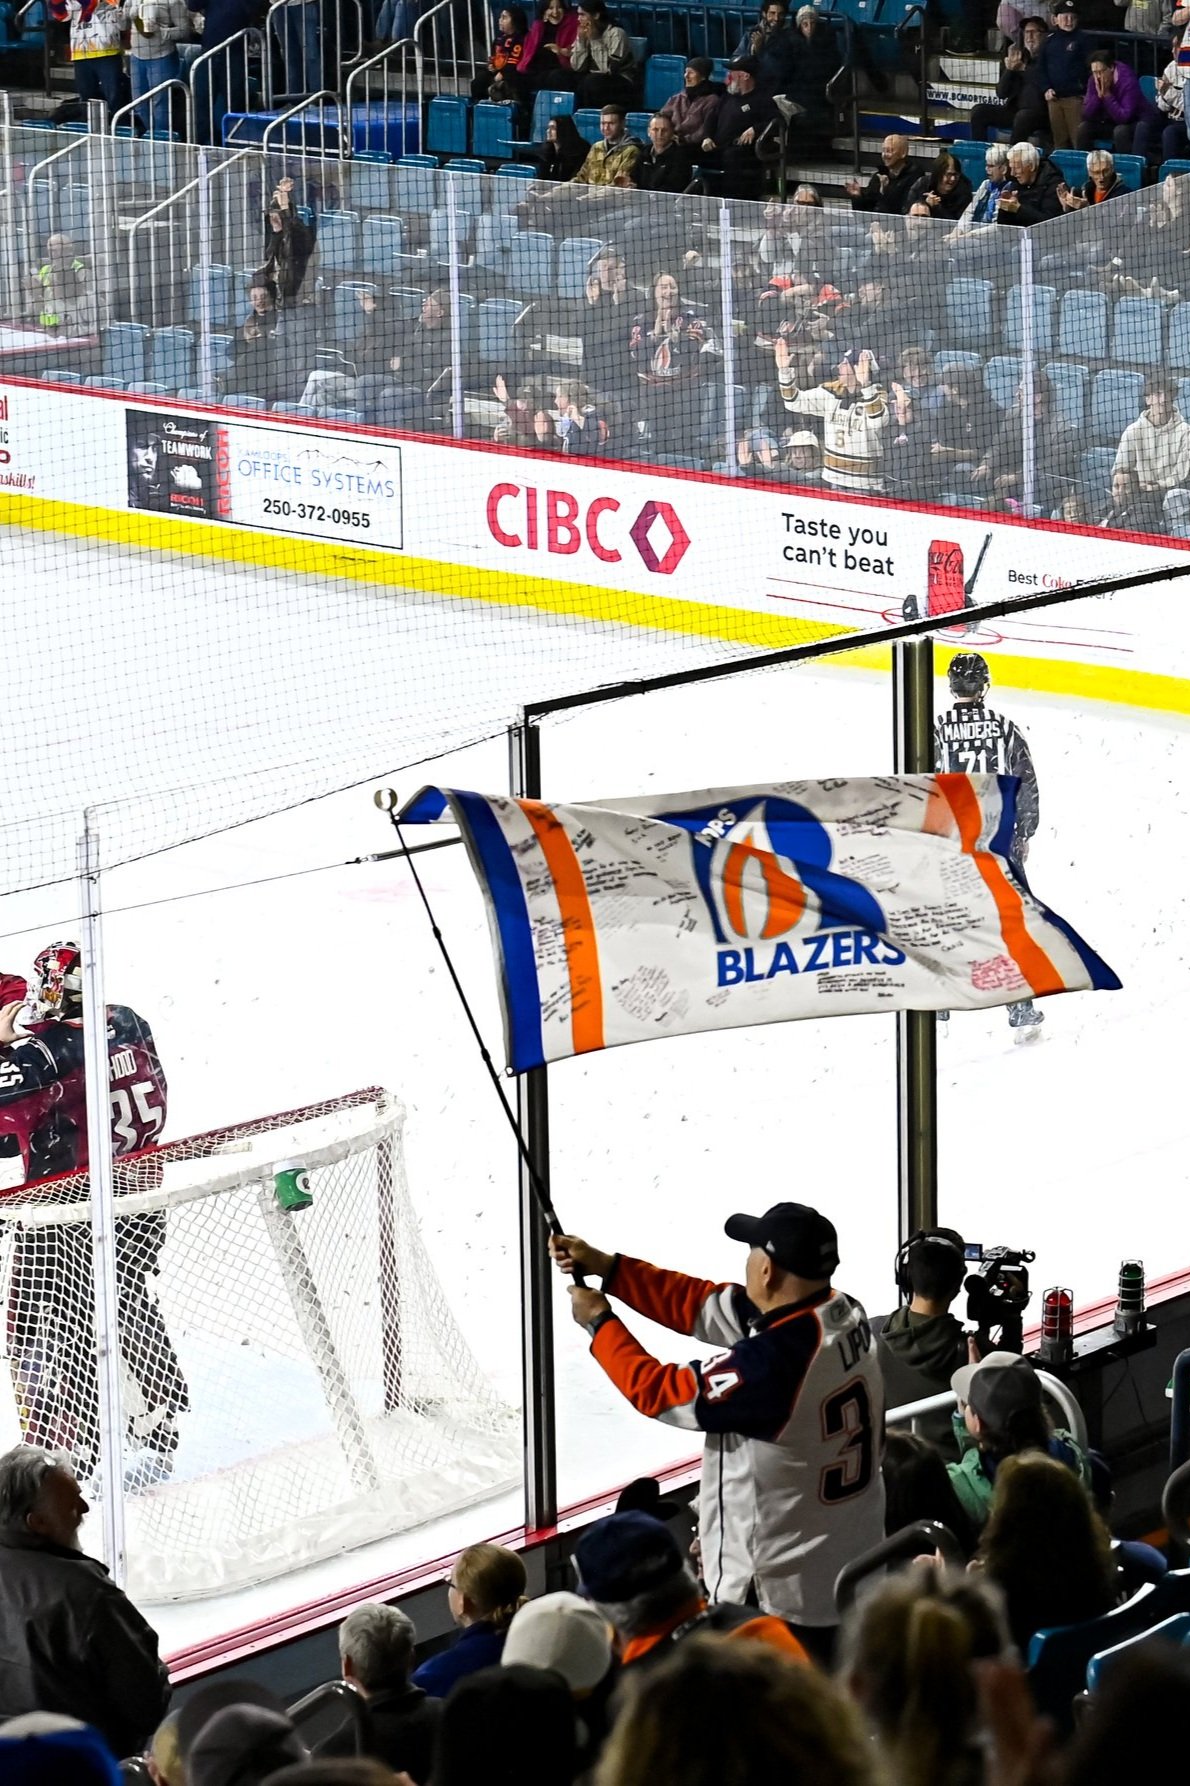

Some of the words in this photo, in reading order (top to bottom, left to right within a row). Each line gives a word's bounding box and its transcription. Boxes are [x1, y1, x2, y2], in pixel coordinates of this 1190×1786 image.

[161, 439, 213, 461] TEAMWORK
[238, 459, 303, 486] OFFICE
[311, 468, 395, 498] SYSTEMS
[263, 498, 371, 529] 250-372-0955
[486, 482, 623, 563] CIBC
[782, 512, 842, 540] Taste
[848, 526, 889, 547] you
[783, 544, 838, 569] can't
[843, 549, 896, 577] beat
[1008, 569, 1039, 586] Best
[943, 720, 1001, 742] MANDERS
[958, 749, 988, 774] 71
[716, 930, 907, 988] BLAZERS
